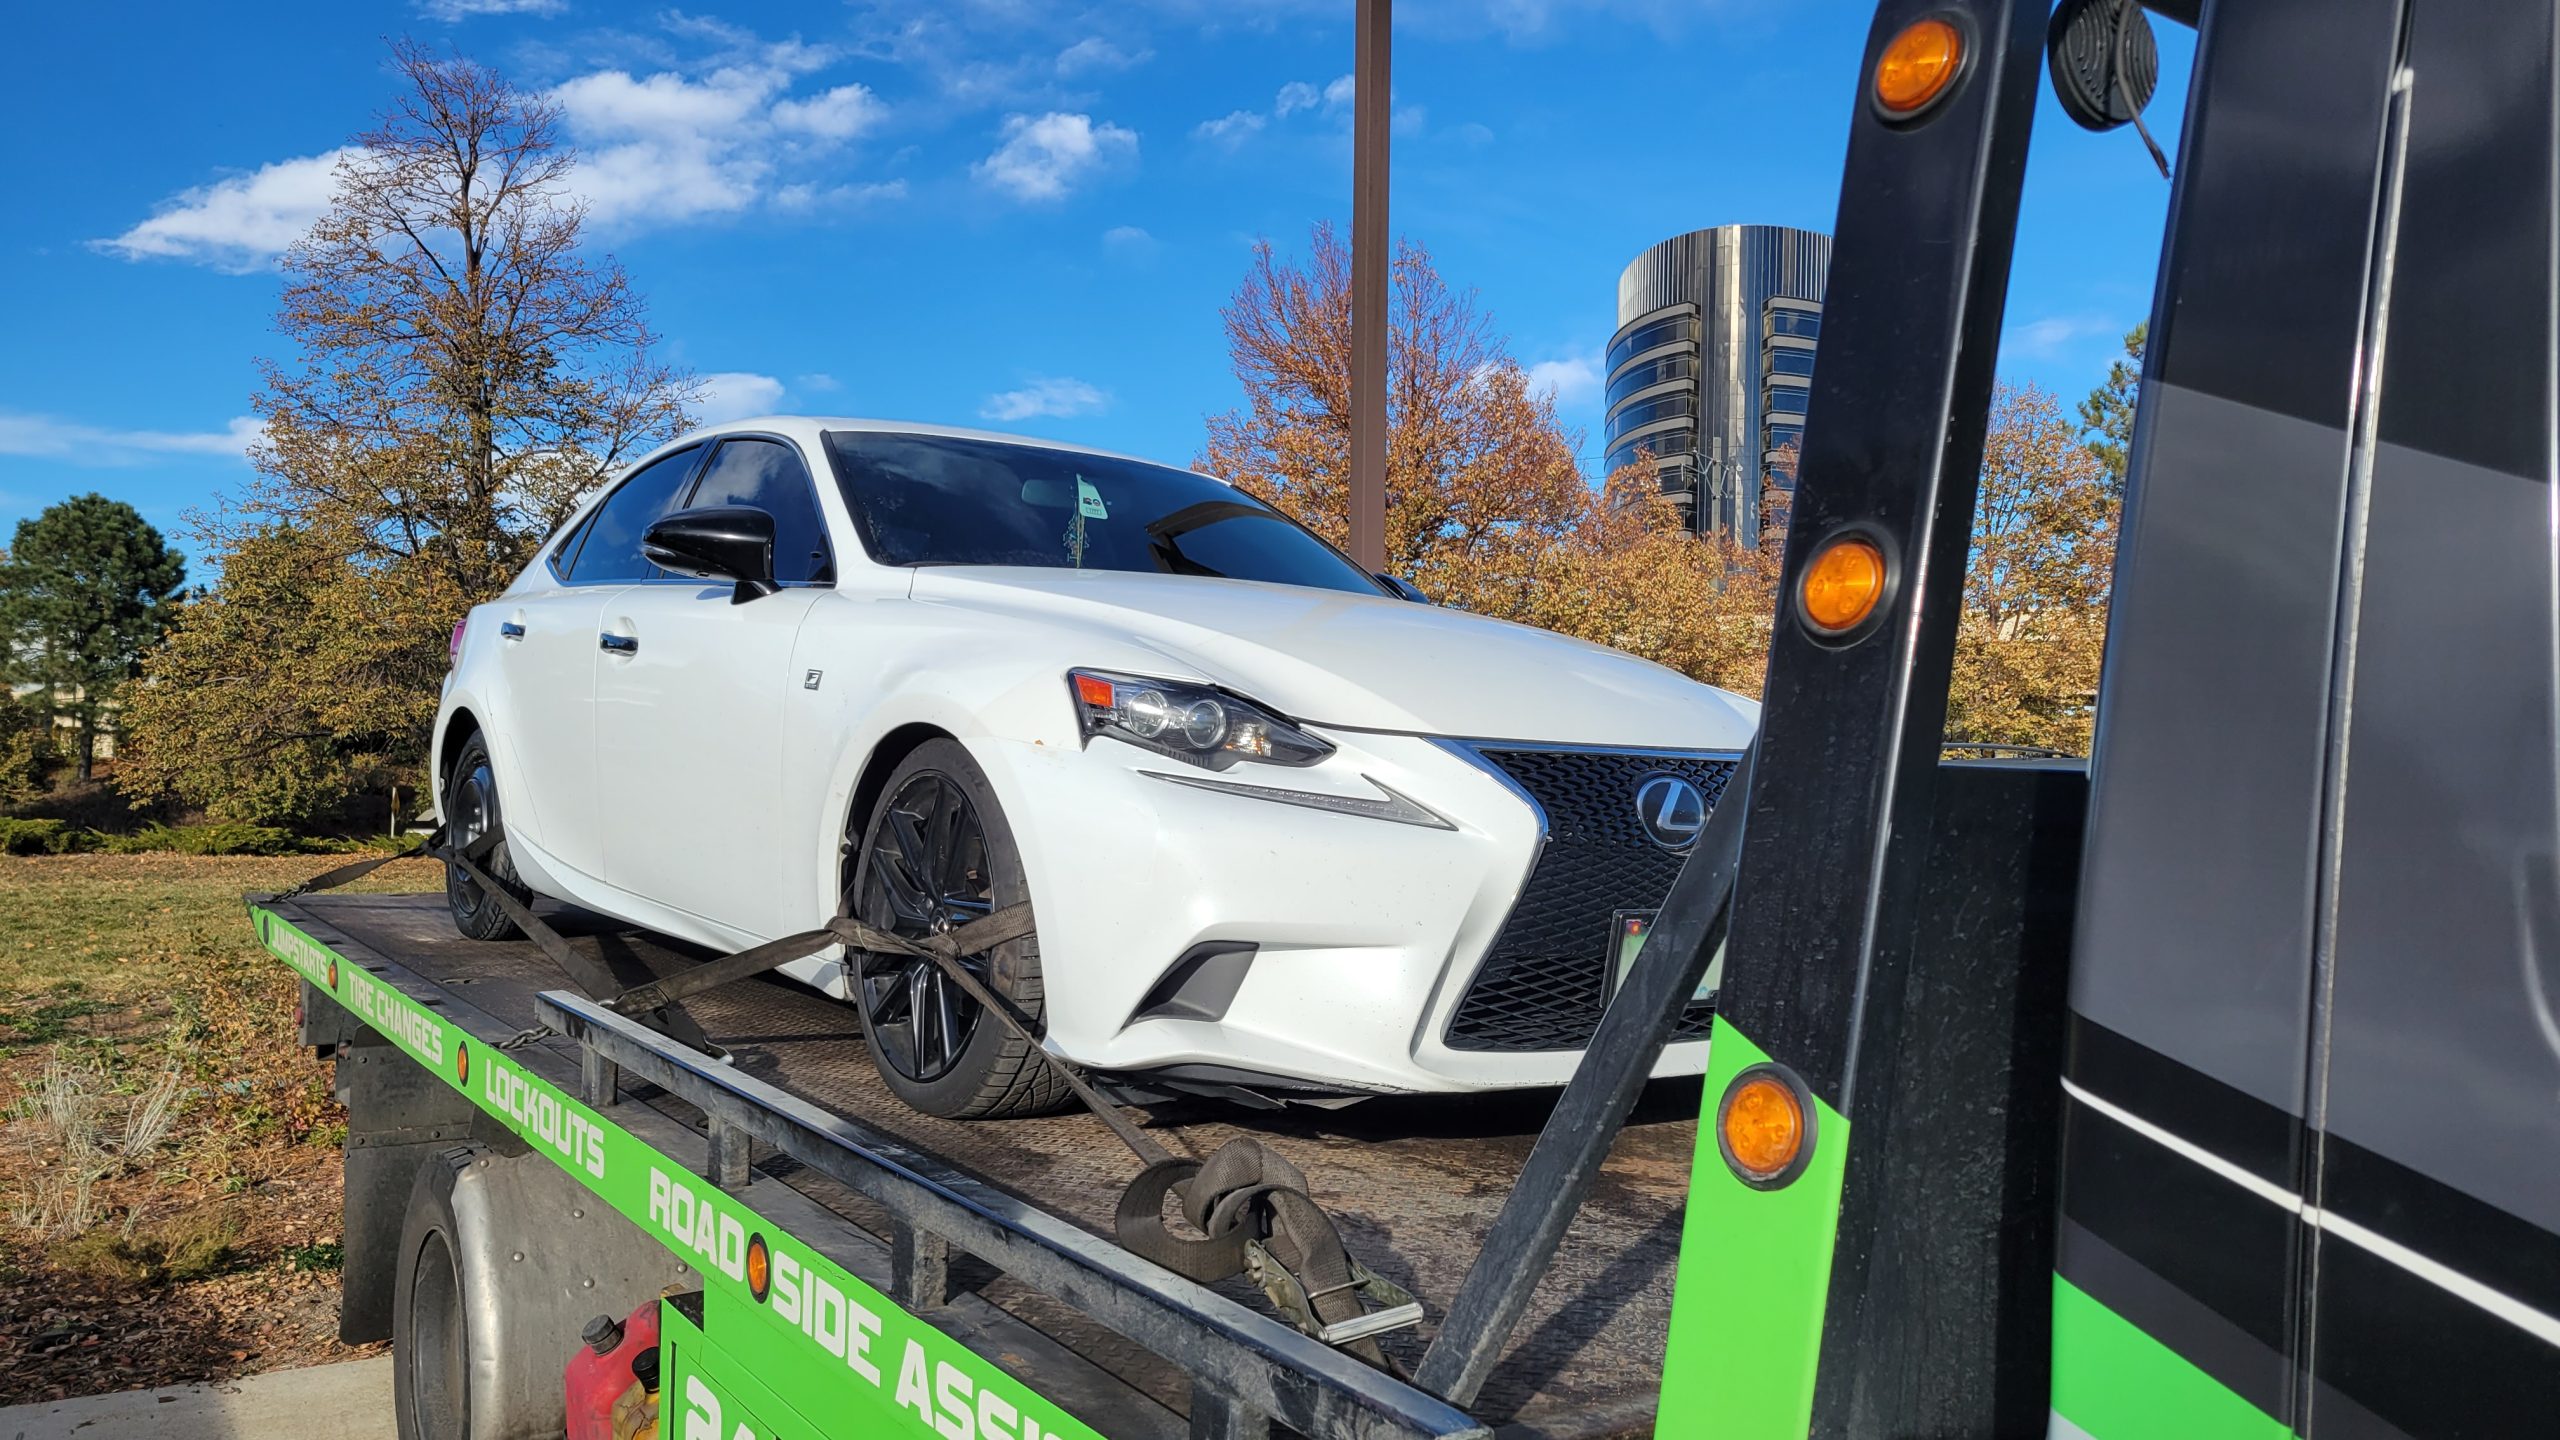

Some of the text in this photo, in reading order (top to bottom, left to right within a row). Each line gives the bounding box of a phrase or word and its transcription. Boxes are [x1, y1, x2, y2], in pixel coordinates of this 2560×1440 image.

[272, 922, 327, 984] JUMPSTARTS
[348, 970, 443, 1065] TIRE CHANGES
[486, 1058, 604, 1179] LOCKOUTS
[649, 1166, 1063, 1440] ROAD SIDE ASS
